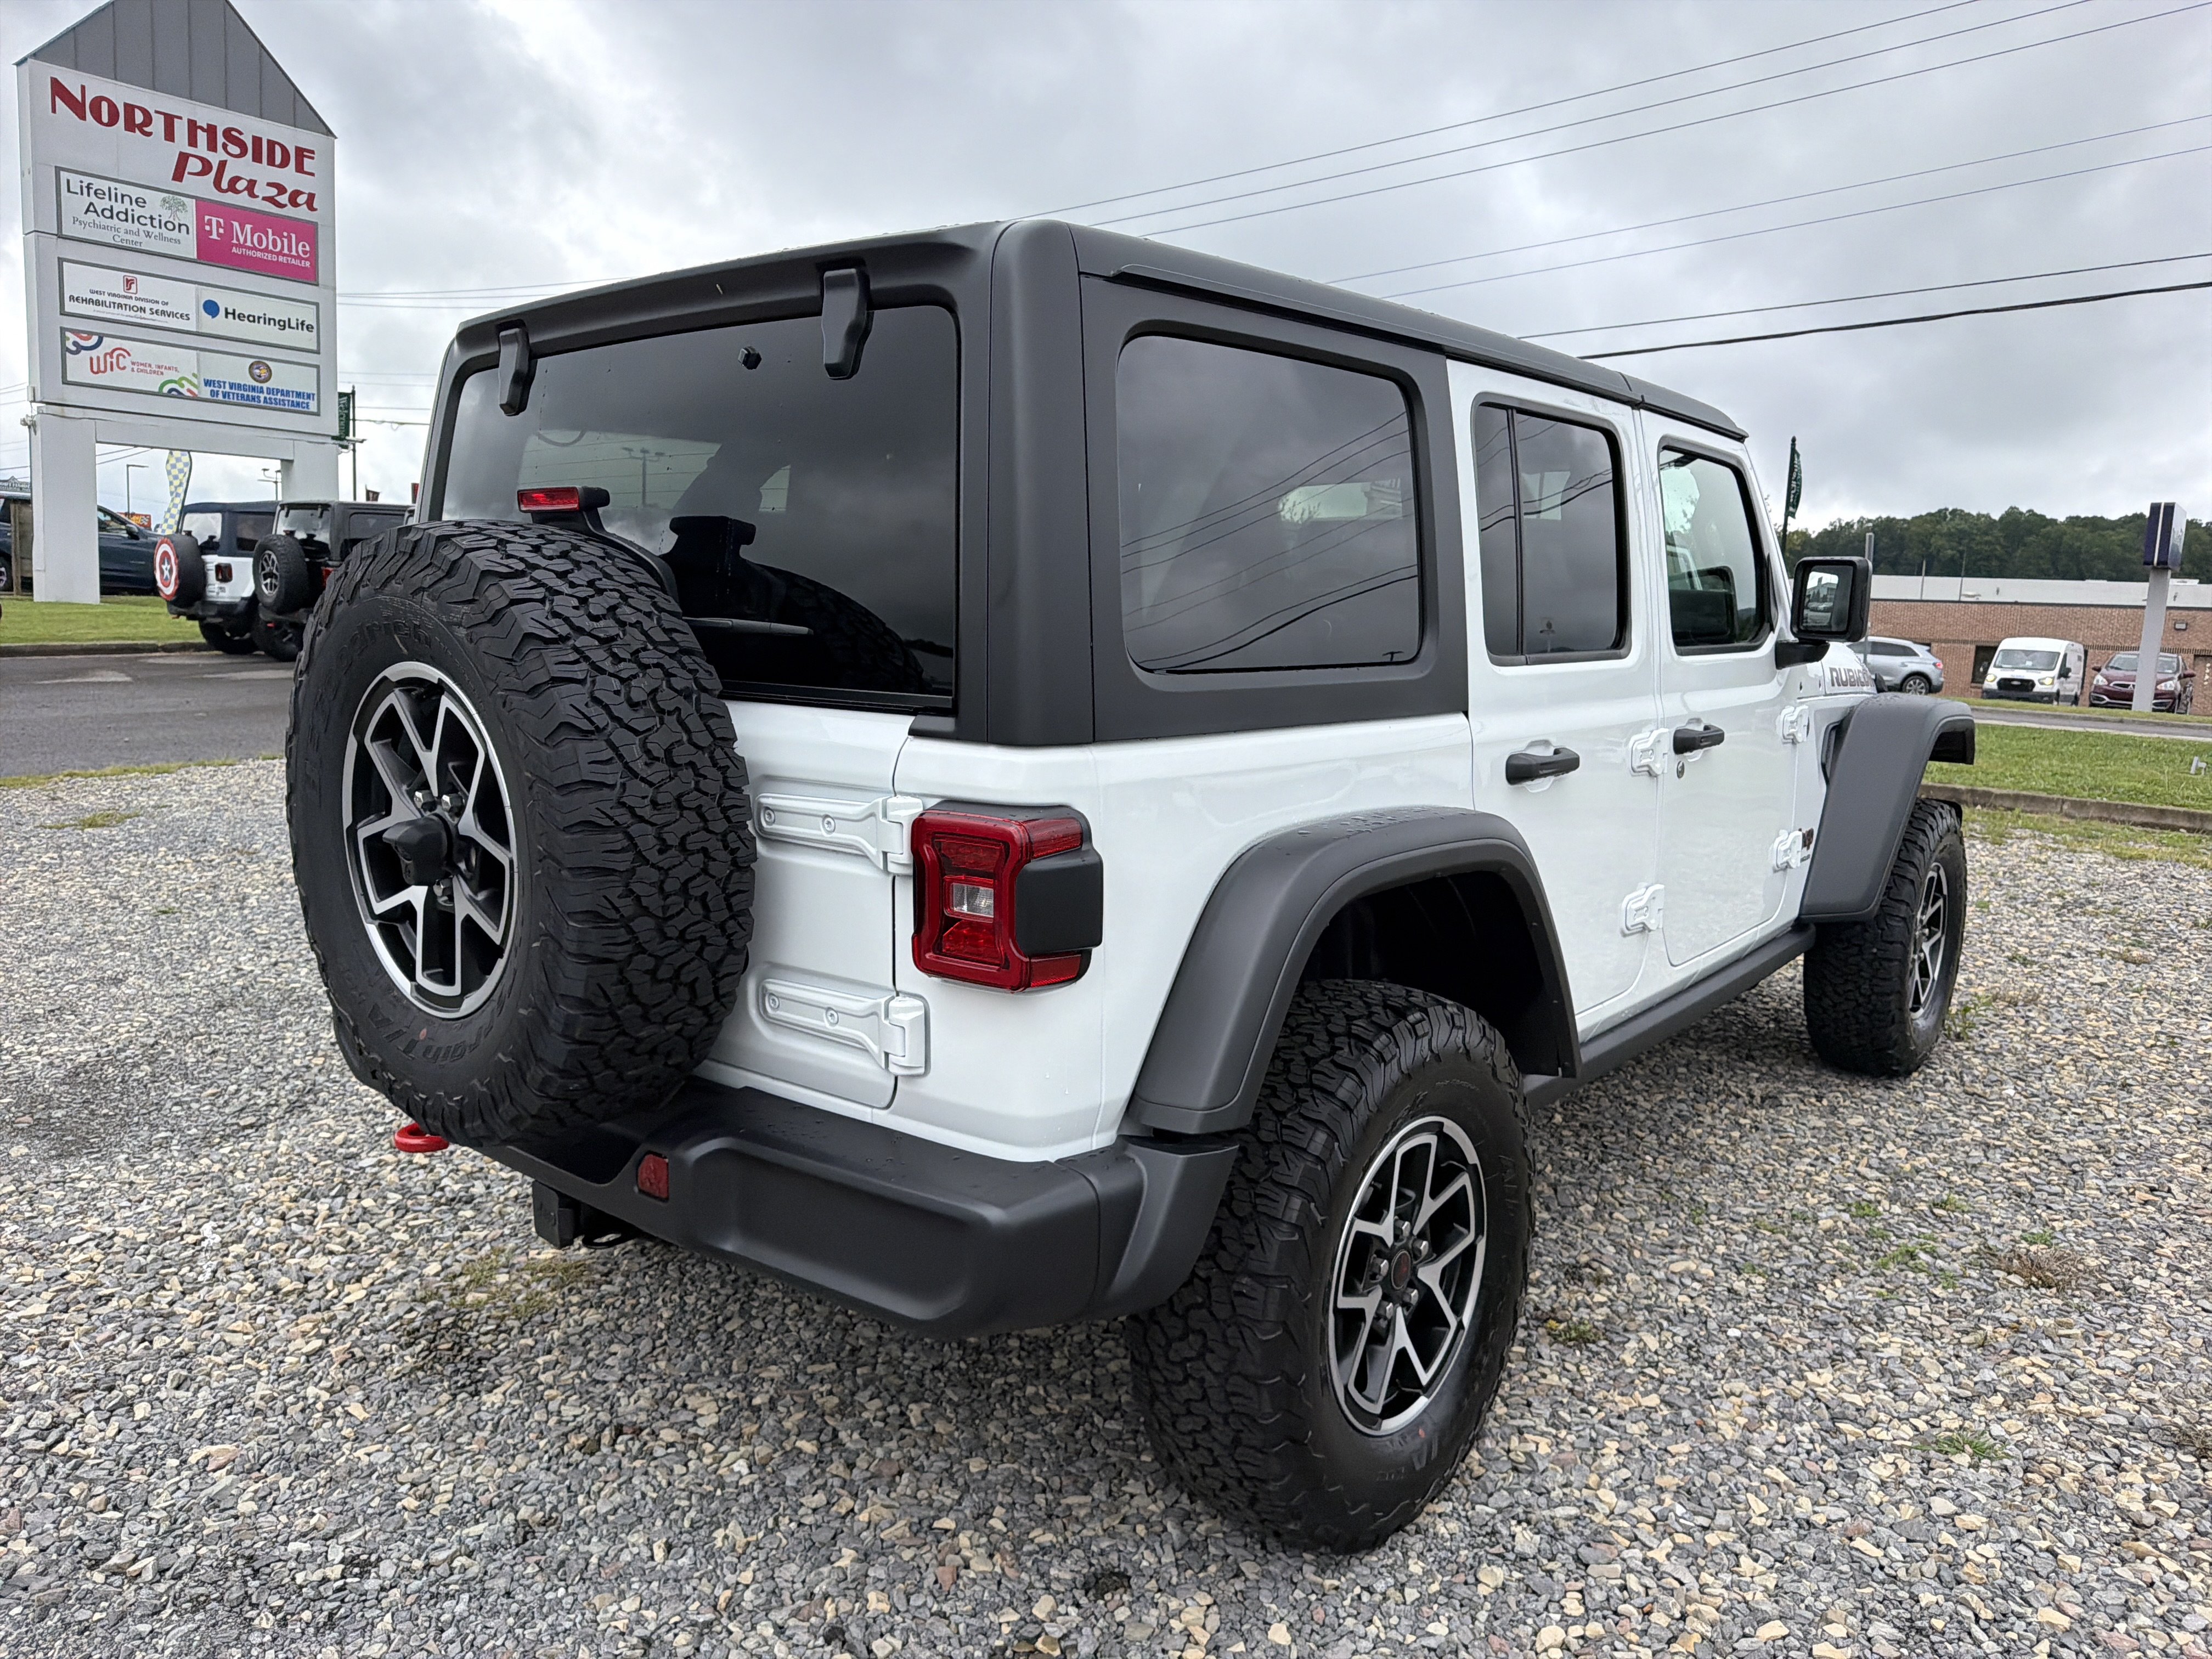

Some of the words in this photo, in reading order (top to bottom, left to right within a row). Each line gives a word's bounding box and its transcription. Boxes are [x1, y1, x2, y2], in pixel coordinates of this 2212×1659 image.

[50, 76, 315, 177] NORTHSIDE
[66, 178, 147, 208] Lifeline
[171, 151, 318, 211] Plaza
[72, 216, 121, 234] Psychiatric
[123, 228, 140, 237] and
[143, 230, 181, 245] Wellness
[84, 201, 190, 235] Addiction
[112, 234, 143, 247] Center
[230, 221, 311, 258] Mobile
[232, 246, 277, 261] AUTHORIZED
[278, 255, 311, 268] RETAILER
[69, 295, 146, 314] REHABILITATION
[149, 308, 190, 321] SERVICES
[107, 291, 133, 300] VIRGINIA
[134, 296, 159, 305] DIVISION
[224, 307, 314, 333] HearingLife
[131, 360, 154, 369] WOMEN,
[155, 364, 180, 373] INFANTS,
[136, 368, 164, 376] CHILDREN
[204, 377, 227, 388] WEST
[228, 381, 264, 394] VIRGINIA
[266, 387, 315, 402] DEPARTMENT
[210, 388, 220, 398] OF
[221, 390, 261, 404] VETERANS
[263, 396, 311, 410] ASSISTANCE
